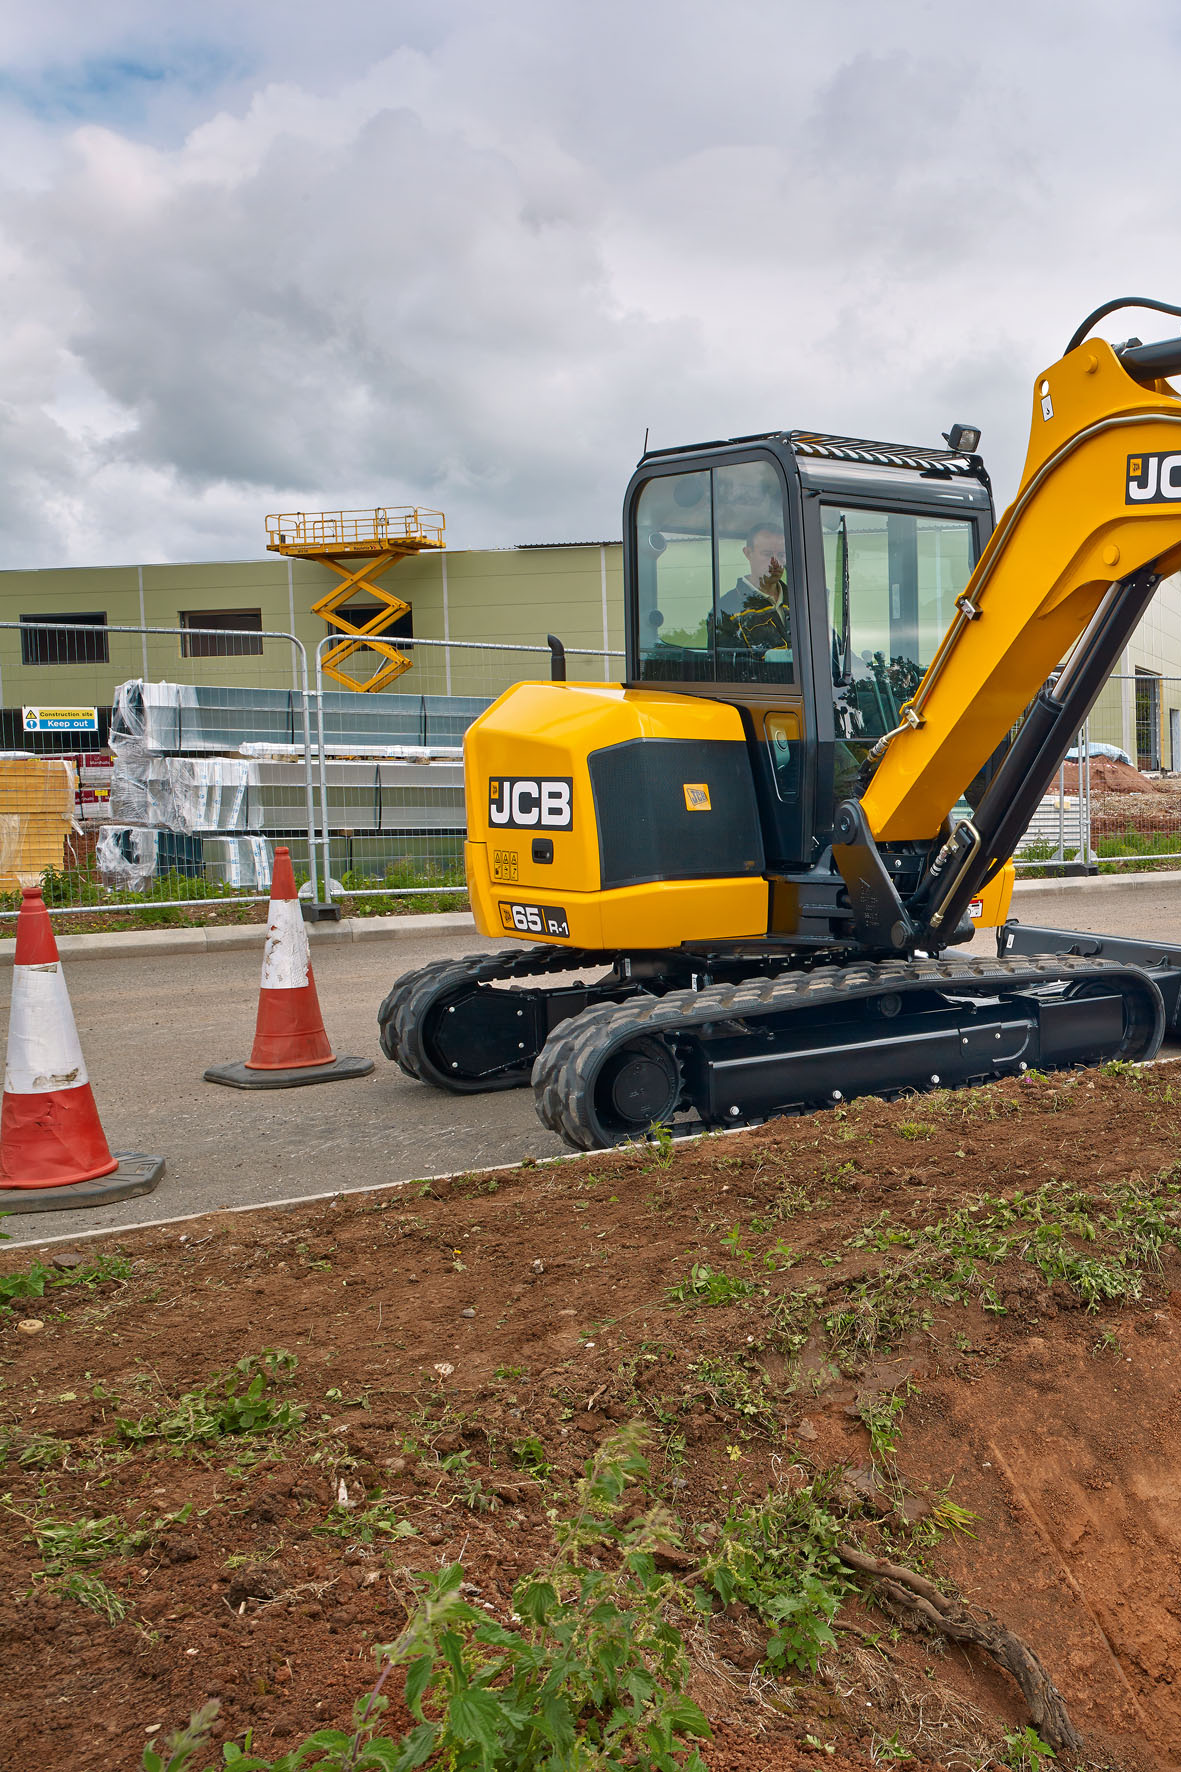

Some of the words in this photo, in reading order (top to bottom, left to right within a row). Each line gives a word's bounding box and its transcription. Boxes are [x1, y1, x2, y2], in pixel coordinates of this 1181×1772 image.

[47, 720, 70, 728] Keep
[490, 781, 571, 826] JCB
[690, 790, 707, 804] JCB
[512, 905, 542, 932] 65
[547, 919, 569, 935] R-1
